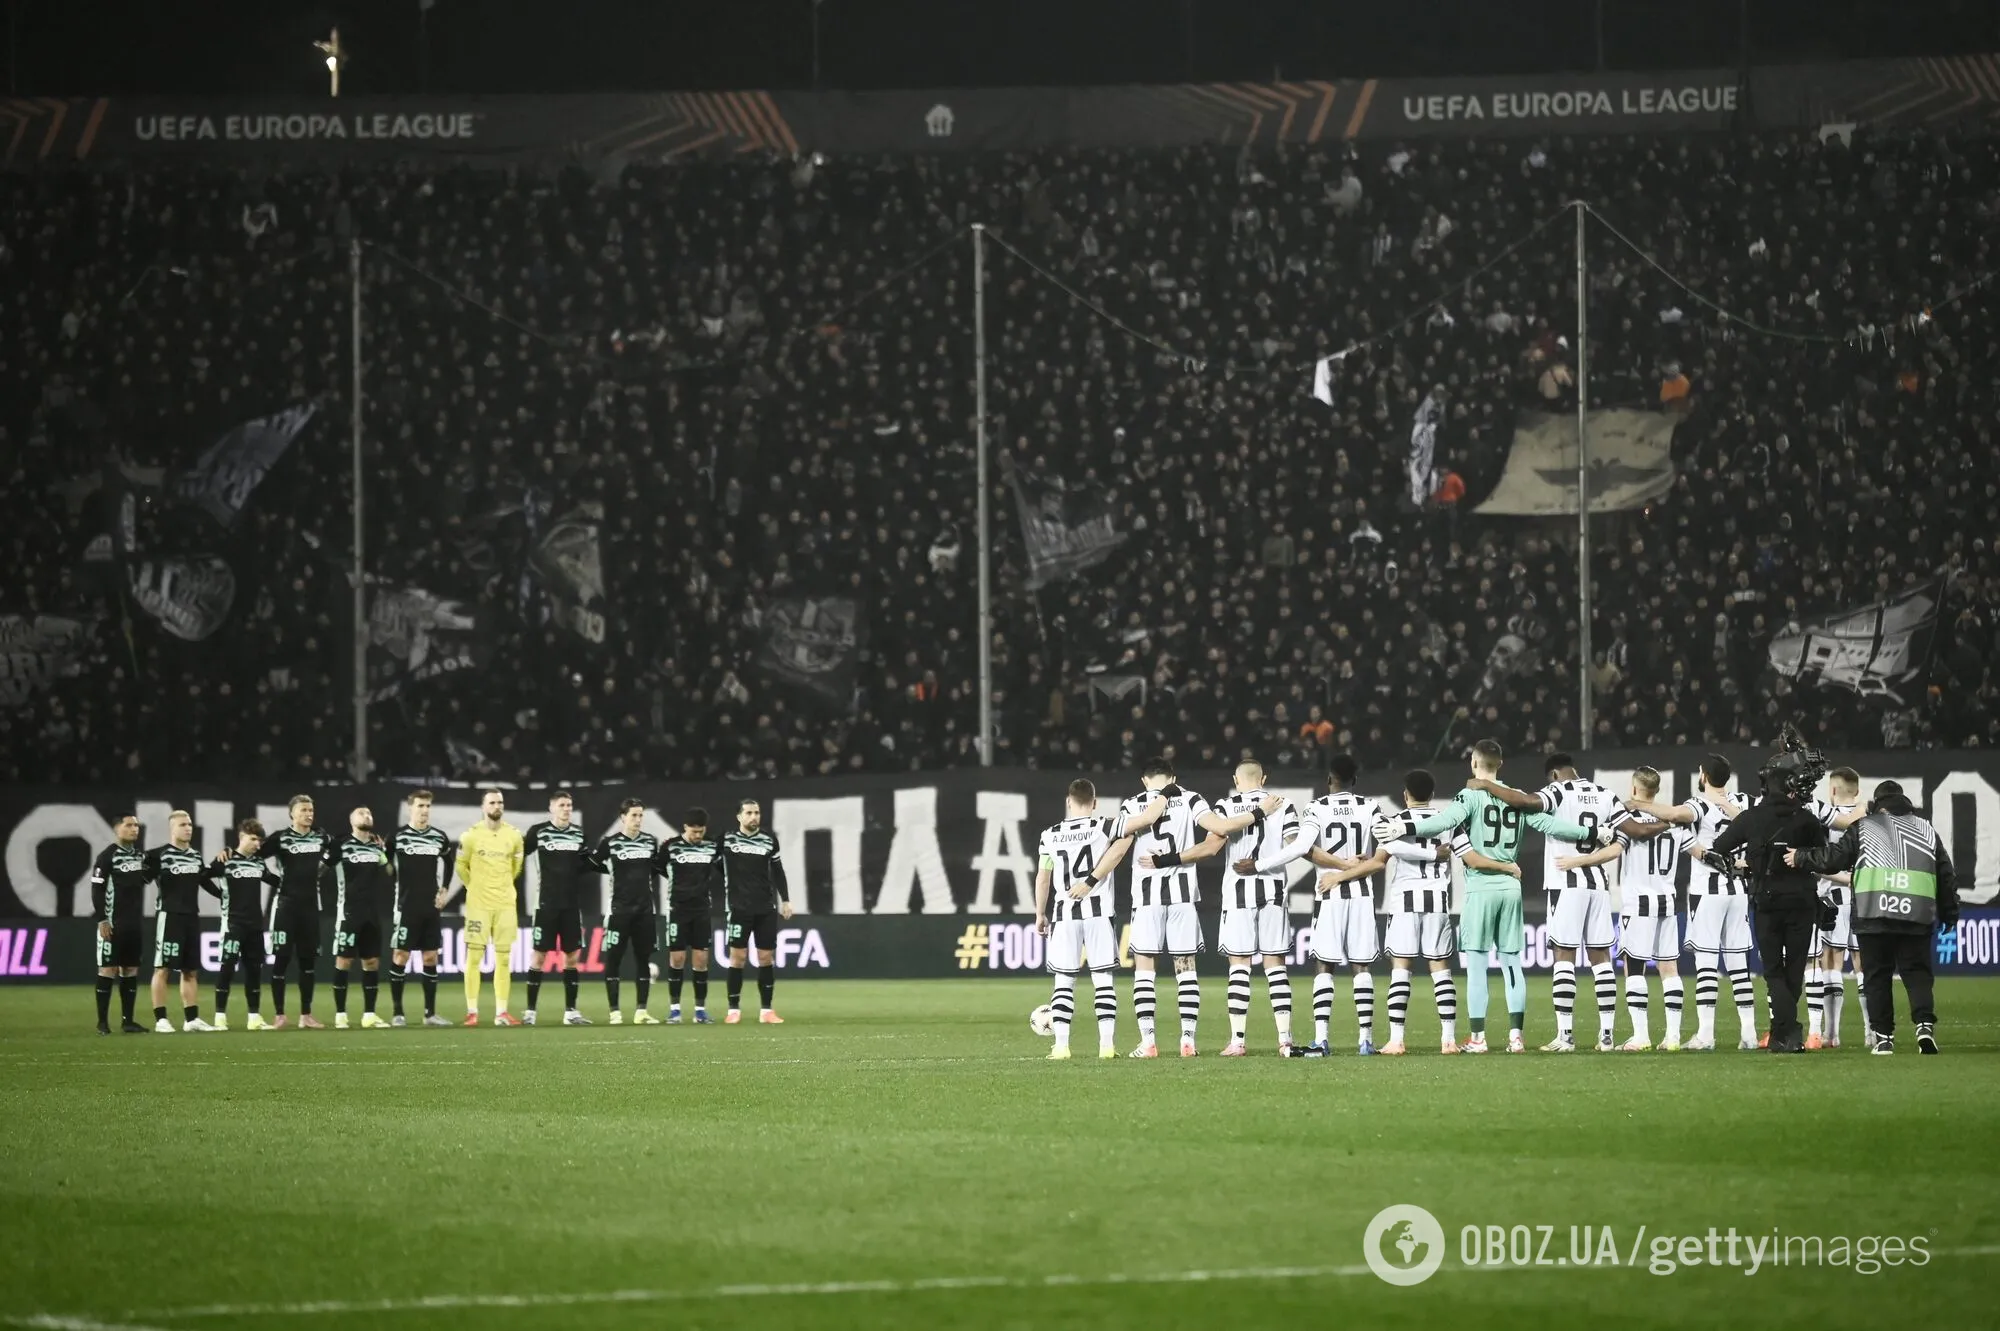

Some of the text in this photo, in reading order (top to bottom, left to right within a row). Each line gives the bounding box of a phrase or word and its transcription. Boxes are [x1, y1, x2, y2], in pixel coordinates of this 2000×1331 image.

[1403, 86, 1738, 121] UEFA EUROPA LEAGUE
[134, 113, 474, 140] UEFA EUROPA LEAGUE
[1333, 807, 1355, 817] BABA
[1152, 814, 1177, 854] 5
[1326, 821, 1363, 856] 21
[1484, 804, 1520, 849] 99
[1576, 812, 1598, 853] 8
[1057, 844, 1095, 891] 14
[1649, 832, 1675, 876] 10
[1883, 870, 1910, 890] HB
[1879, 893, 1912, 915] 026
[338, 932, 355, 947] 24
[607, 930, 620, 945] 16
[729, 924, 742, 938] 12
[163, 942, 179, 957] 52
